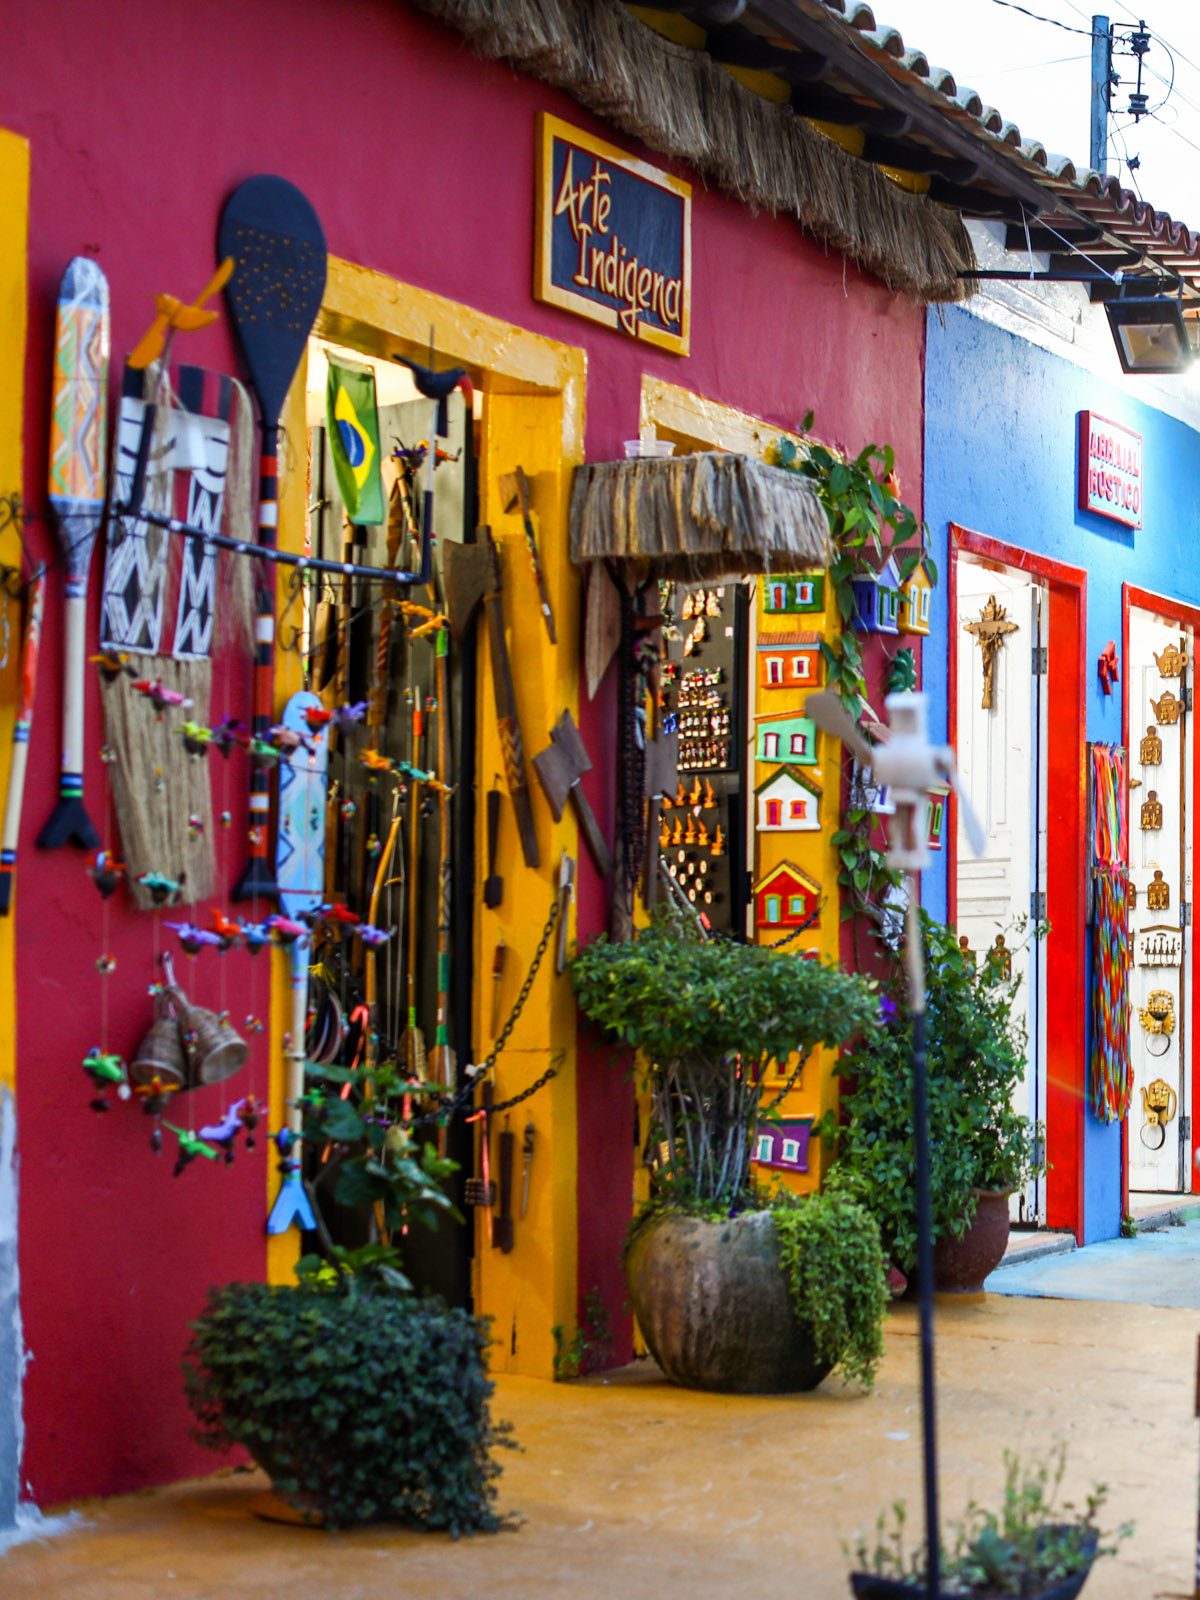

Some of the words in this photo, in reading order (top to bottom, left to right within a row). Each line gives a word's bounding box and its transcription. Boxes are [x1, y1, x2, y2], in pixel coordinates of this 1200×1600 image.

[554, 149, 611, 242] Arte
[573, 223, 682, 335] Indigena
[1090, 431, 1139, 477] ARRAIAL
